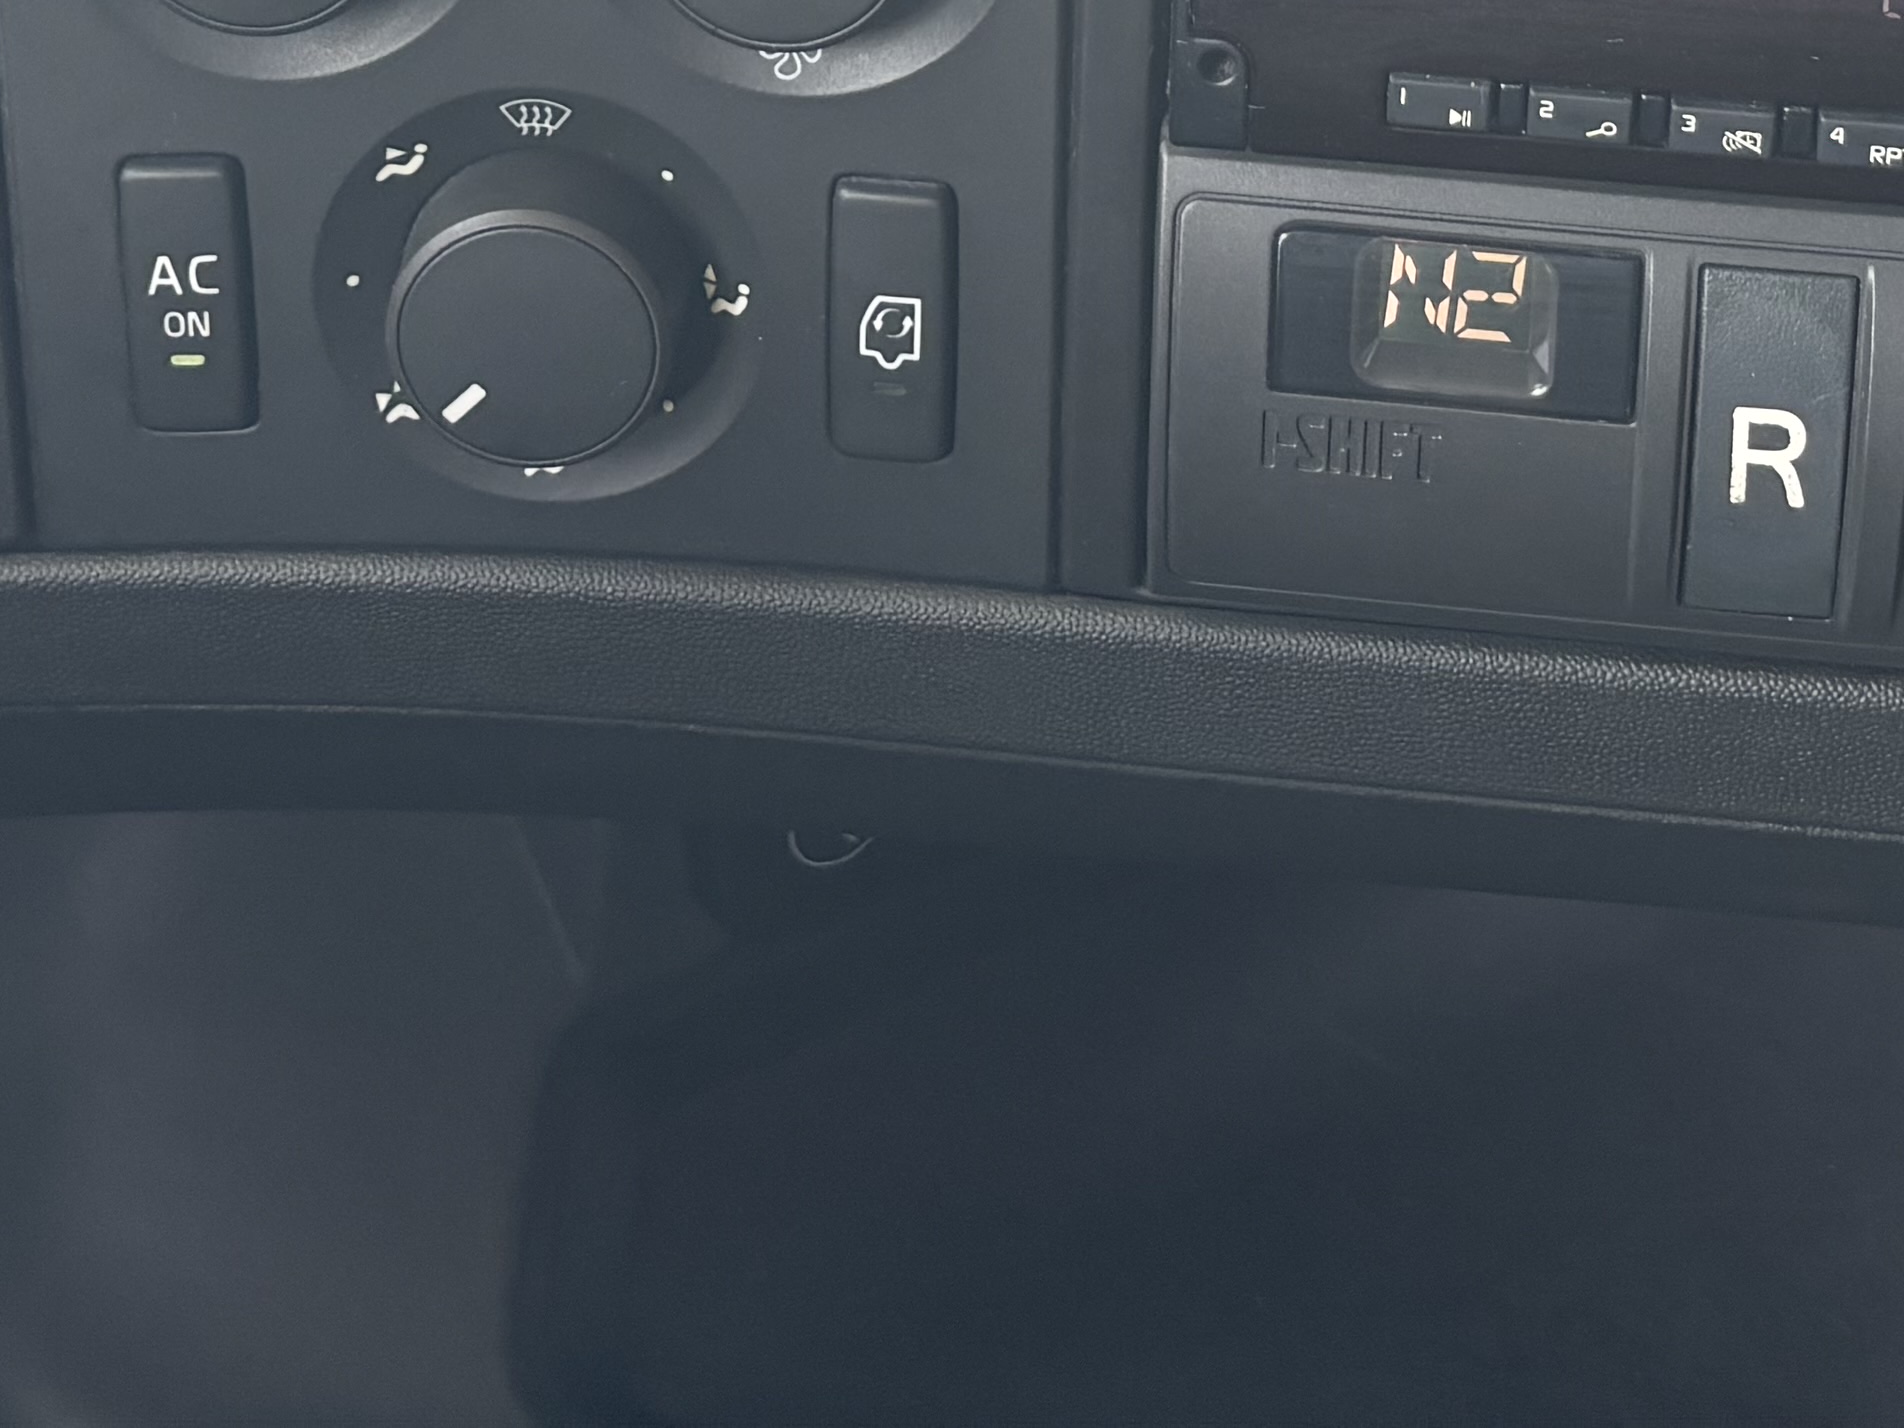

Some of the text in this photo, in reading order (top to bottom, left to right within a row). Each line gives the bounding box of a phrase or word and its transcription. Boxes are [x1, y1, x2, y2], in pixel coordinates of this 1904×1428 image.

[1399, 86, 1407, 106] 1
[1538, 99, 1555, 119] 2
[1680, 114, 1697, 133] 3
[1829, 126, 1846, 146] 4
[148, 254, 220, 297] AC
[162, 310, 211, 339] ON
[1728, 405, 1809, 510] R
